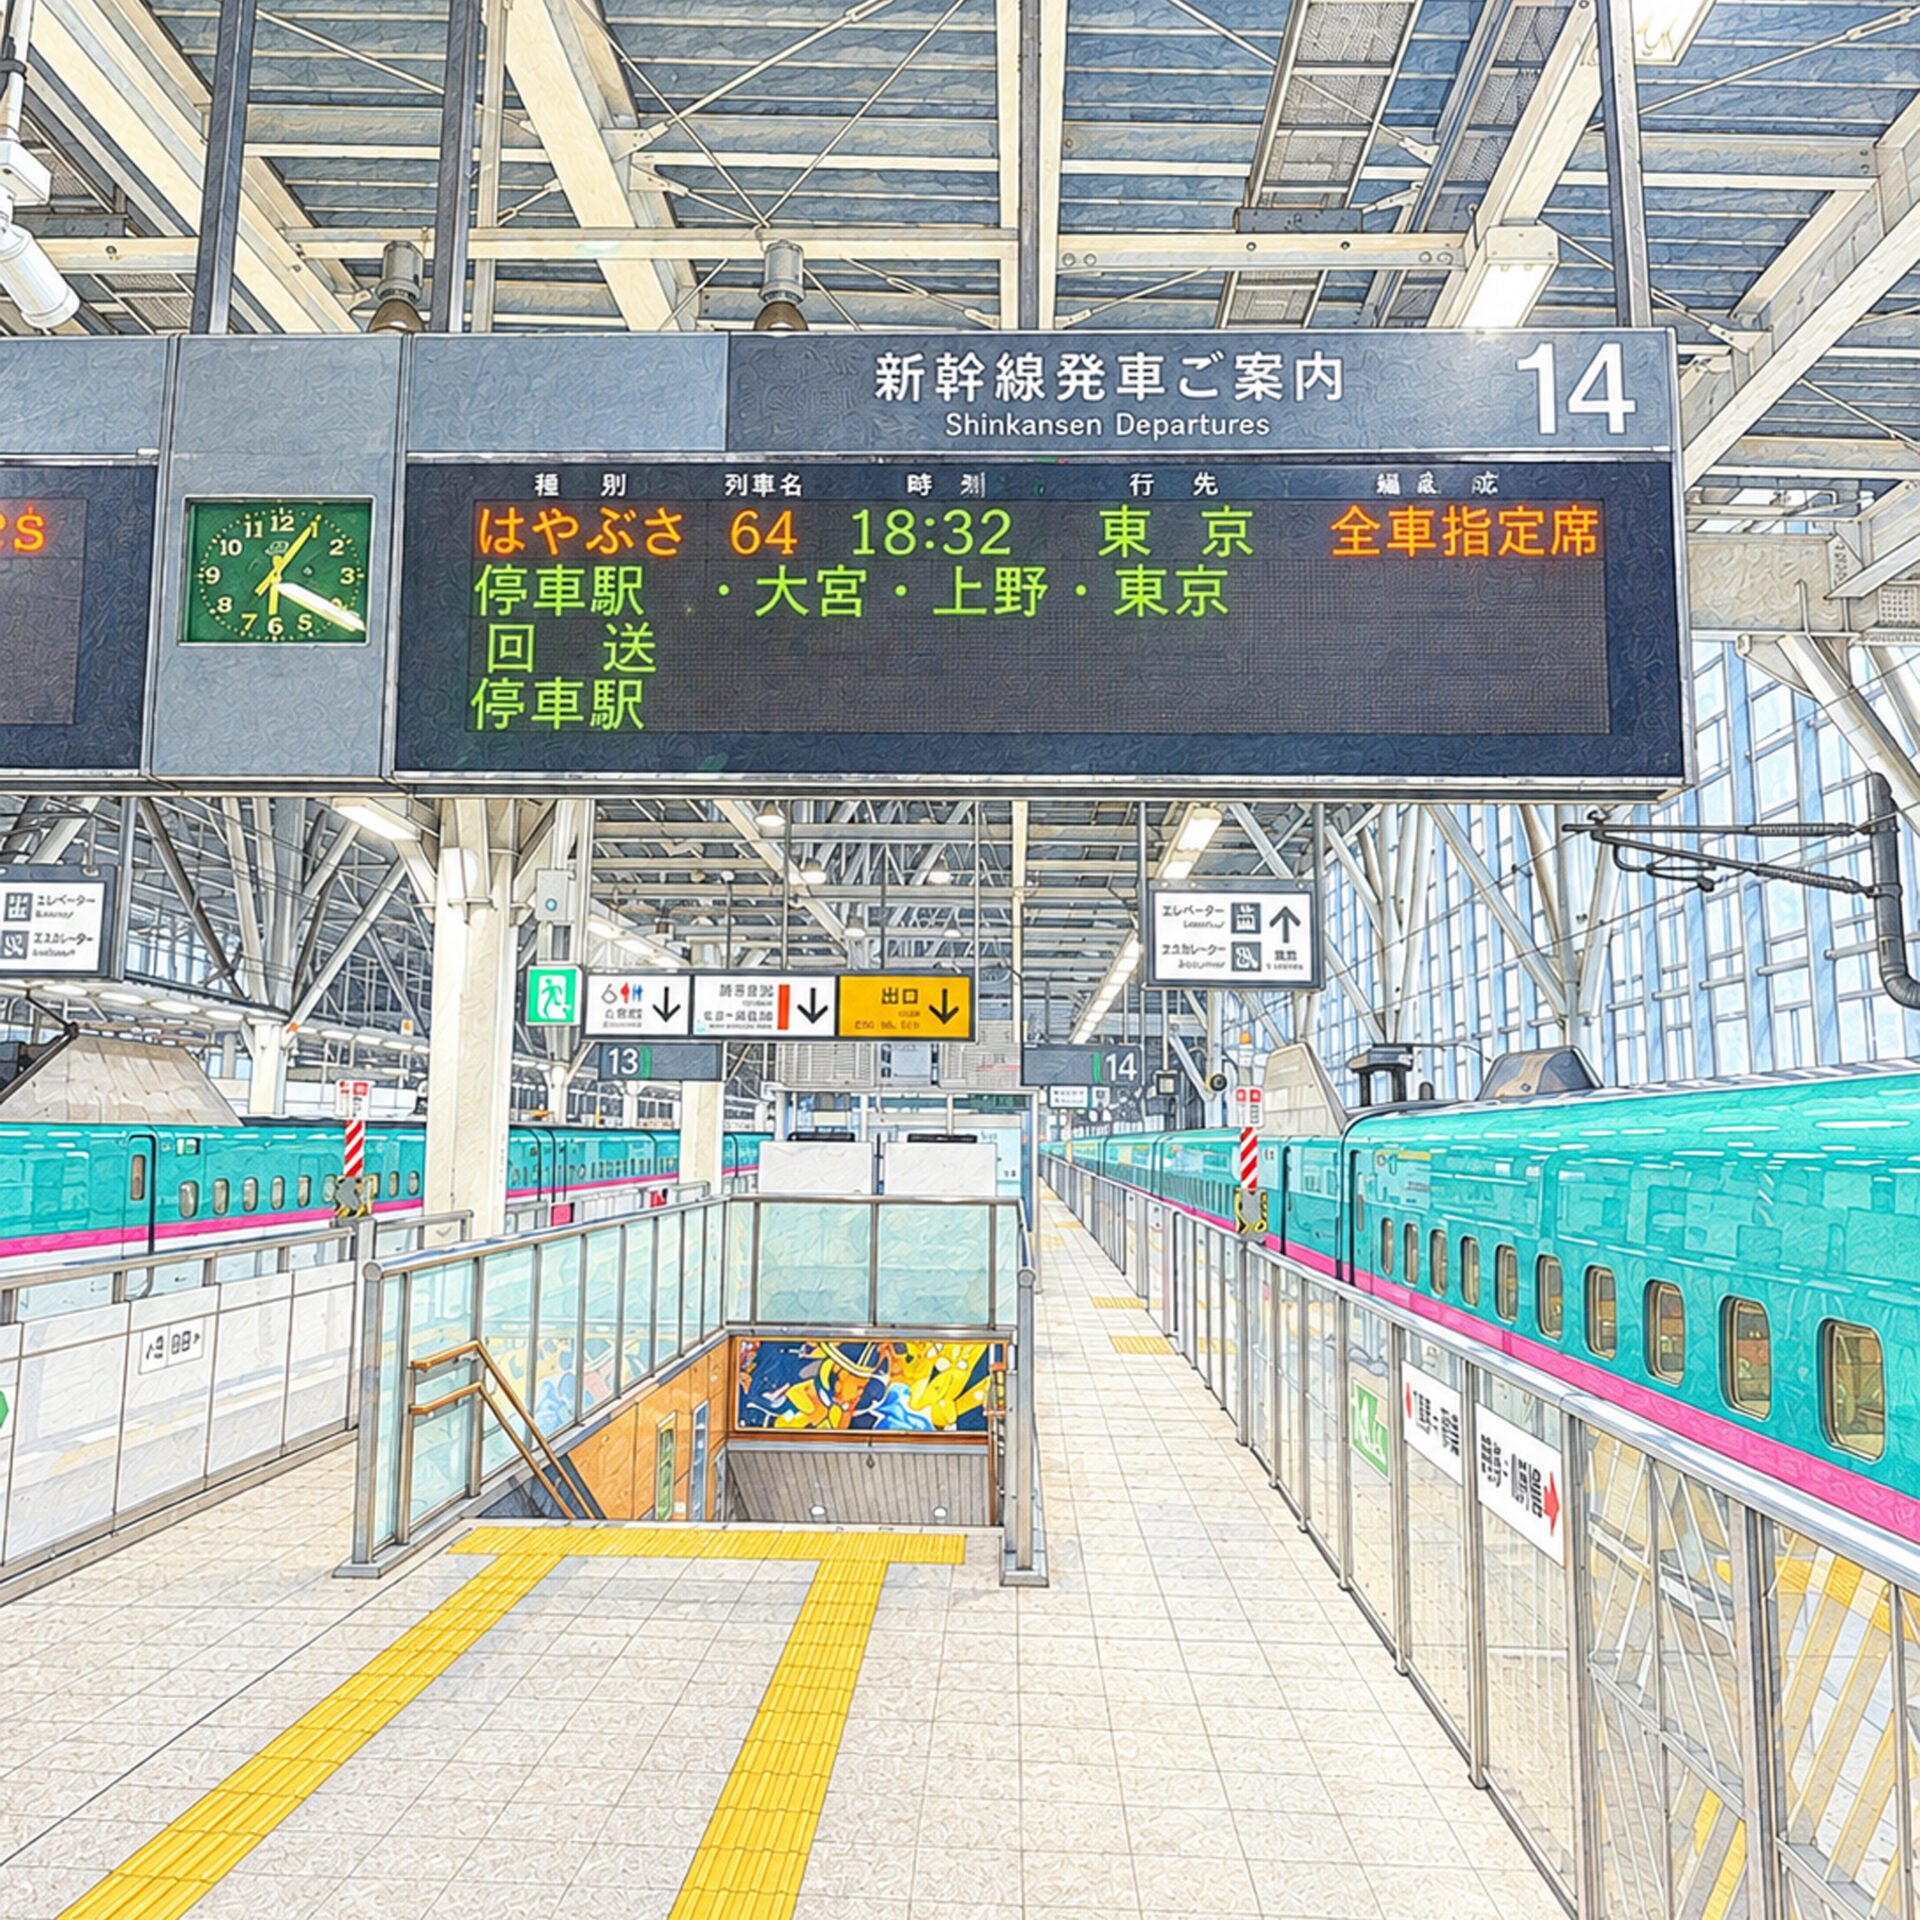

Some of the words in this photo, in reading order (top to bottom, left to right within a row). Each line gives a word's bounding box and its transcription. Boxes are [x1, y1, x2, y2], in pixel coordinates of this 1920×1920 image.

[875, 351, 1343, 402] 新幹線発車ご案内
[1516, 342, 1636, 434] 14
[945, 413, 1101, 436] Shinkansen
[1116, 413, 1270, 441] Departures
[725, 473, 802, 497] 列車名
[244, 520, 263, 538] 11
[270, 515, 295, 532] 12
[479, 506, 684, 557] はやぶさ
[729, 509, 798, 556] 64
[852, 508, 1012, 556] 18:32
[1099, 505, 1254, 558] 東京
[1330, 504, 1599, 558] 全車指定席
[220, 538, 242, 556] 10
[329, 538, 345, 556] 2
[205, 566, 221, 585] 9
[340, 567, 355, 584] 3
[474, 563, 644, 617] 停車駅
[217, 596, 232, 613] 8
[241, 613, 258, 631] 7
[267, 616, 284, 635] 6
[487, 621, 656, 674] 回送
[471, 677, 644, 731] 停車駅
[881, 986, 918, 1005] 出口
[608, 1047, 639, 1076] 13
[1105, 1052, 1138, 1081] 14
